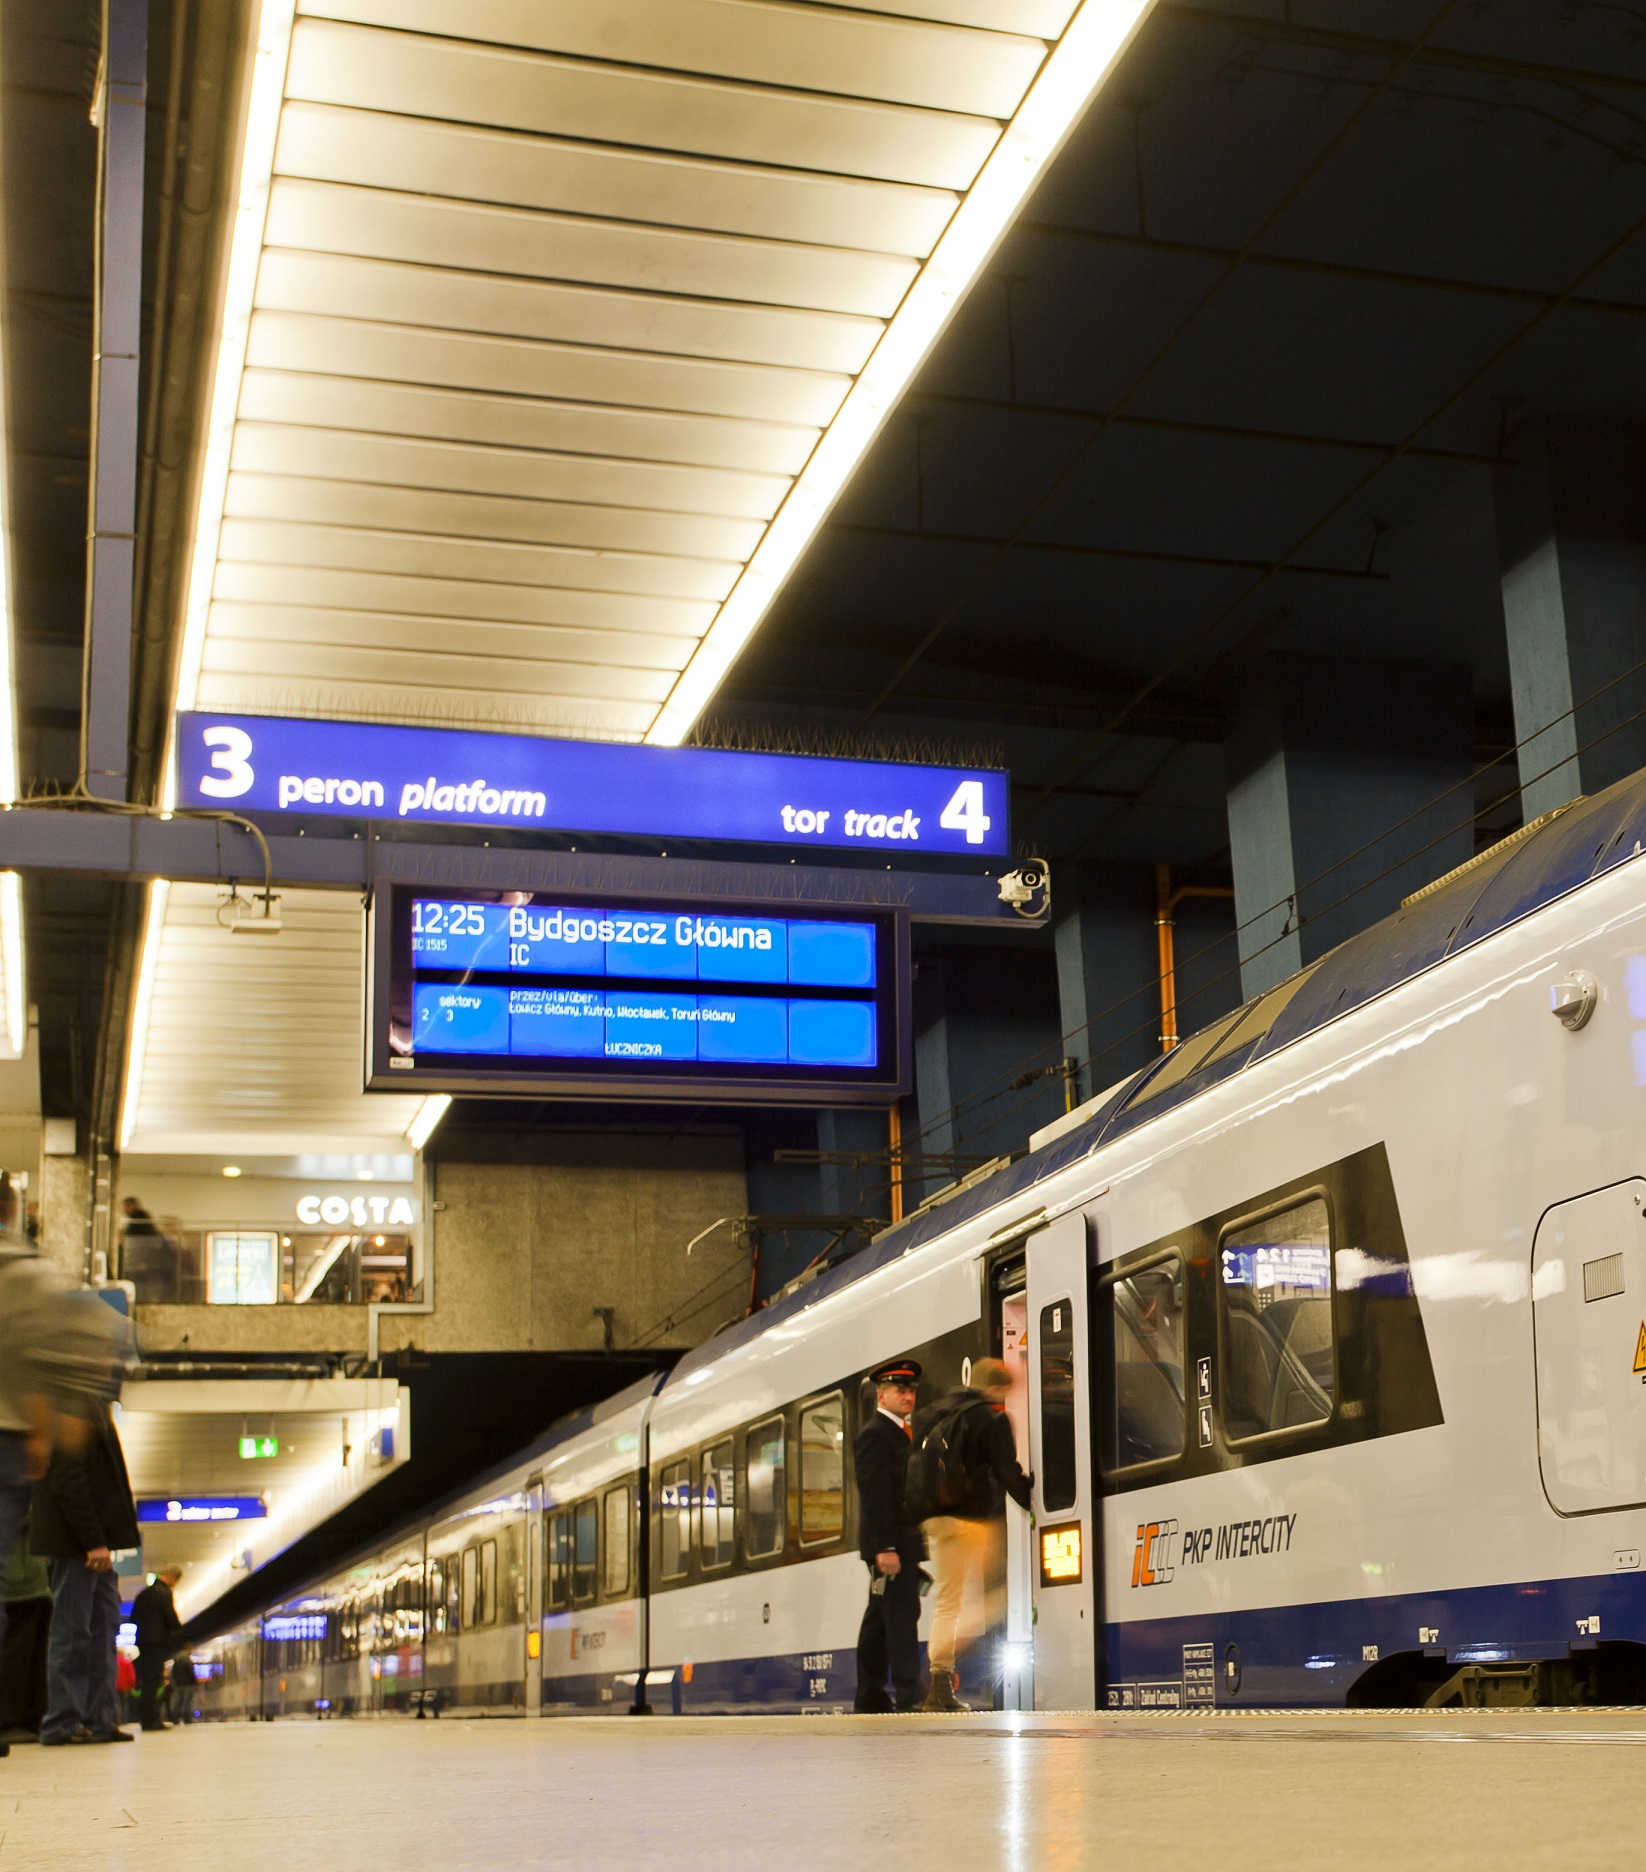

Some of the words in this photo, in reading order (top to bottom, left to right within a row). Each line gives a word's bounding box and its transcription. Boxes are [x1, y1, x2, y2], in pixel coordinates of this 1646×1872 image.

[200, 726, 254, 798] 3
[279, 775, 385, 809] peron
[399, 777, 546, 816] platform
[781, 805, 830, 834] tor
[844, 809, 921, 840] track
[940, 780, 990, 844] 4
[412, 903, 485, 935] 12:25
[509, 907, 667, 945] Bydgoszcz
[675, 916, 772, 950] Główna
[426, 939, 447, 952] 1515
[509, 944, 530, 966] IC
[421, 1009, 429, 1021] 2
[446, 1009, 454, 1022] 3
[296, 1195, 414, 1227] COSTA
[1182, 1528, 1212, 1565] PKP
[1215, 1513, 1297, 1560] INTERCITY
